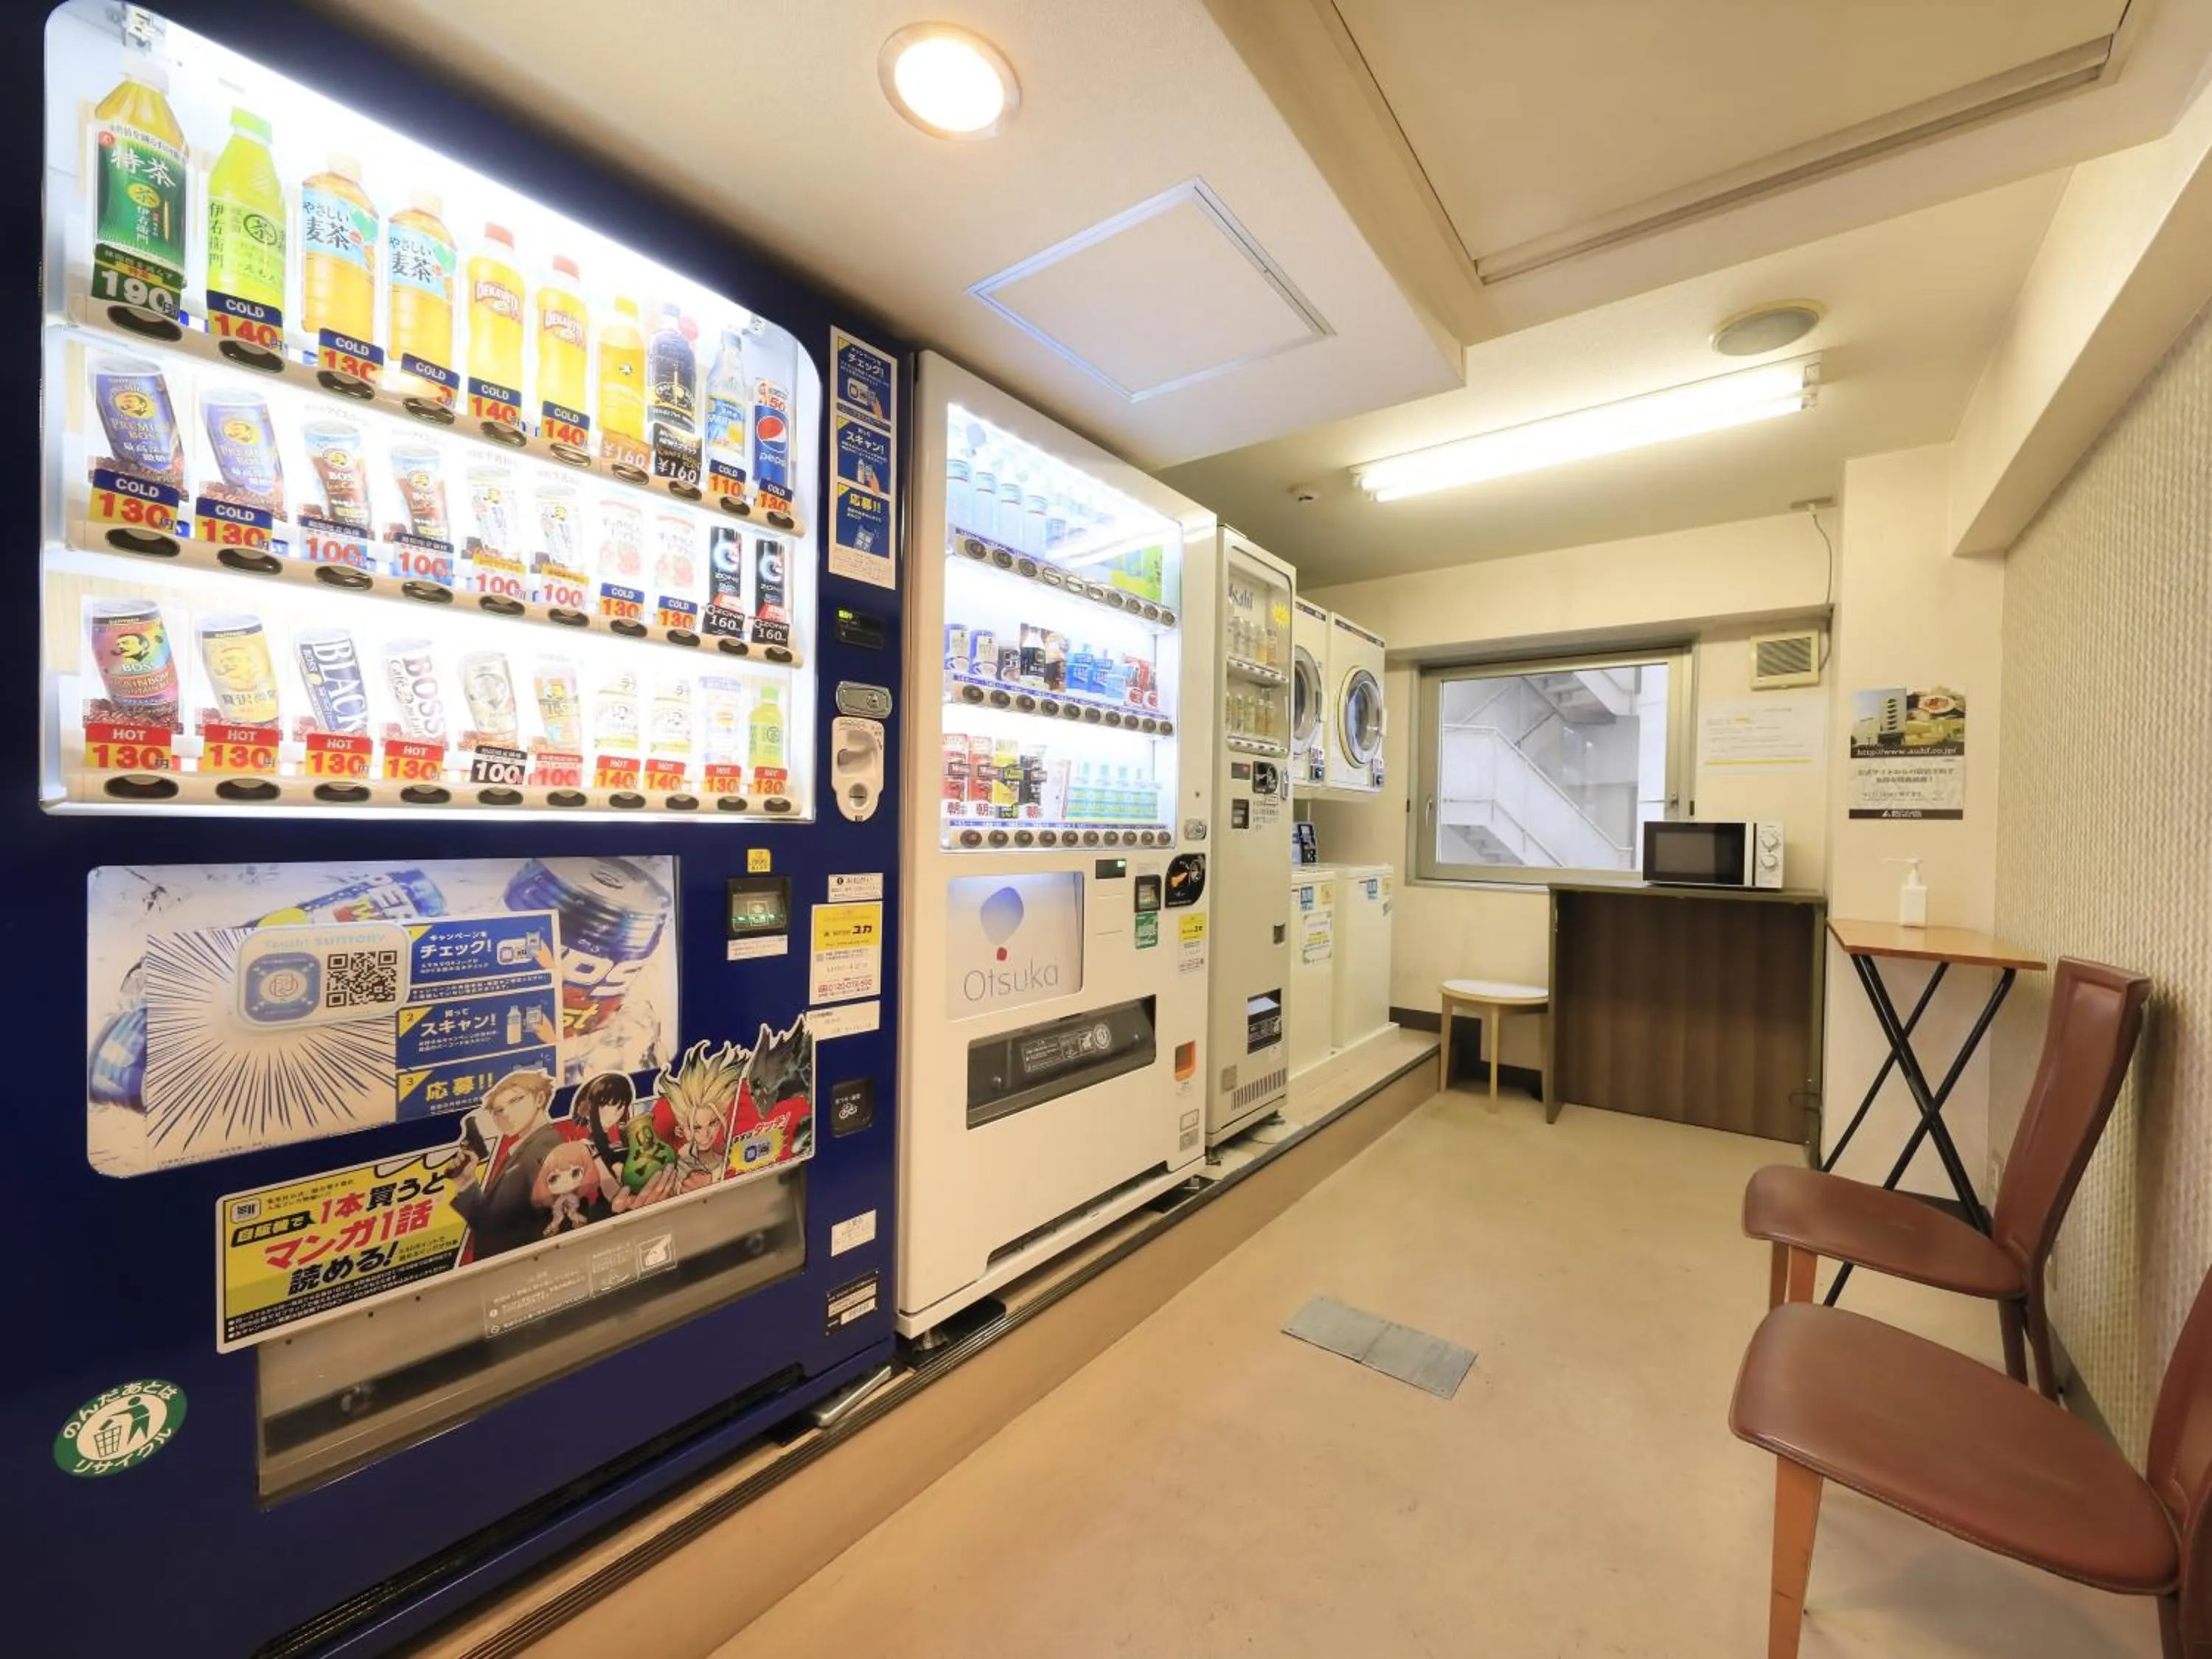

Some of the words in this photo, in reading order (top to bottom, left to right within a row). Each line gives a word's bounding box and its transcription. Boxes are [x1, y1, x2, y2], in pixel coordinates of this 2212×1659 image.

[111, 147, 175, 187] 特茶
[302, 201, 349, 222] やさしい
[306, 216, 350, 251] 麦茶
[389, 236, 431, 256] やさしい
[392, 254, 432, 283] 麦茶
[226, 298, 265, 319] COLD
[335, 337, 369, 357] COLD
[415, 361, 446, 380] COLD
[481, 383, 509, 401] COLD
[554, 408, 579, 424] COLD
[658, 457, 697, 483] ¥160
[719, 465, 738, 477] COLD
[115, 479, 159, 498] COLD
[768, 483, 785, 496] COLD
[215, 504, 255, 521] COLD
[611, 587, 635, 599] COLD
[668, 598, 689, 611] COLD
[313, 639, 367, 732] BLACK
[403, 655, 446, 735] BOSS
[113, 728, 146, 741] HOT
[228, 729, 257, 742] HOT
[327, 739, 354, 750] HOT
[404, 745, 428, 757] HOT
[611, 759, 628, 768] HOT
[658, 762, 674, 771] HOT
[429, 931, 487, 942] キャンペーンを
[420, 939, 492, 959] チェック!
[964, 957, 1059, 1002] Otsuka
[406, 1013, 414, 1022] 2
[420, 1013, 496, 1037] スキャン!
[406, 1077, 414, 1086] 3
[425, 1072, 494, 1101] 応募!!
[320, 1172, 445, 1225] 1本買うと
[265, 1197, 433, 1269] マンガ1話
[288, 1240, 398, 1295] 読める!
[63, 1380, 178, 1439] のんだあとは
[73, 1427, 172, 1474] リサイクル
